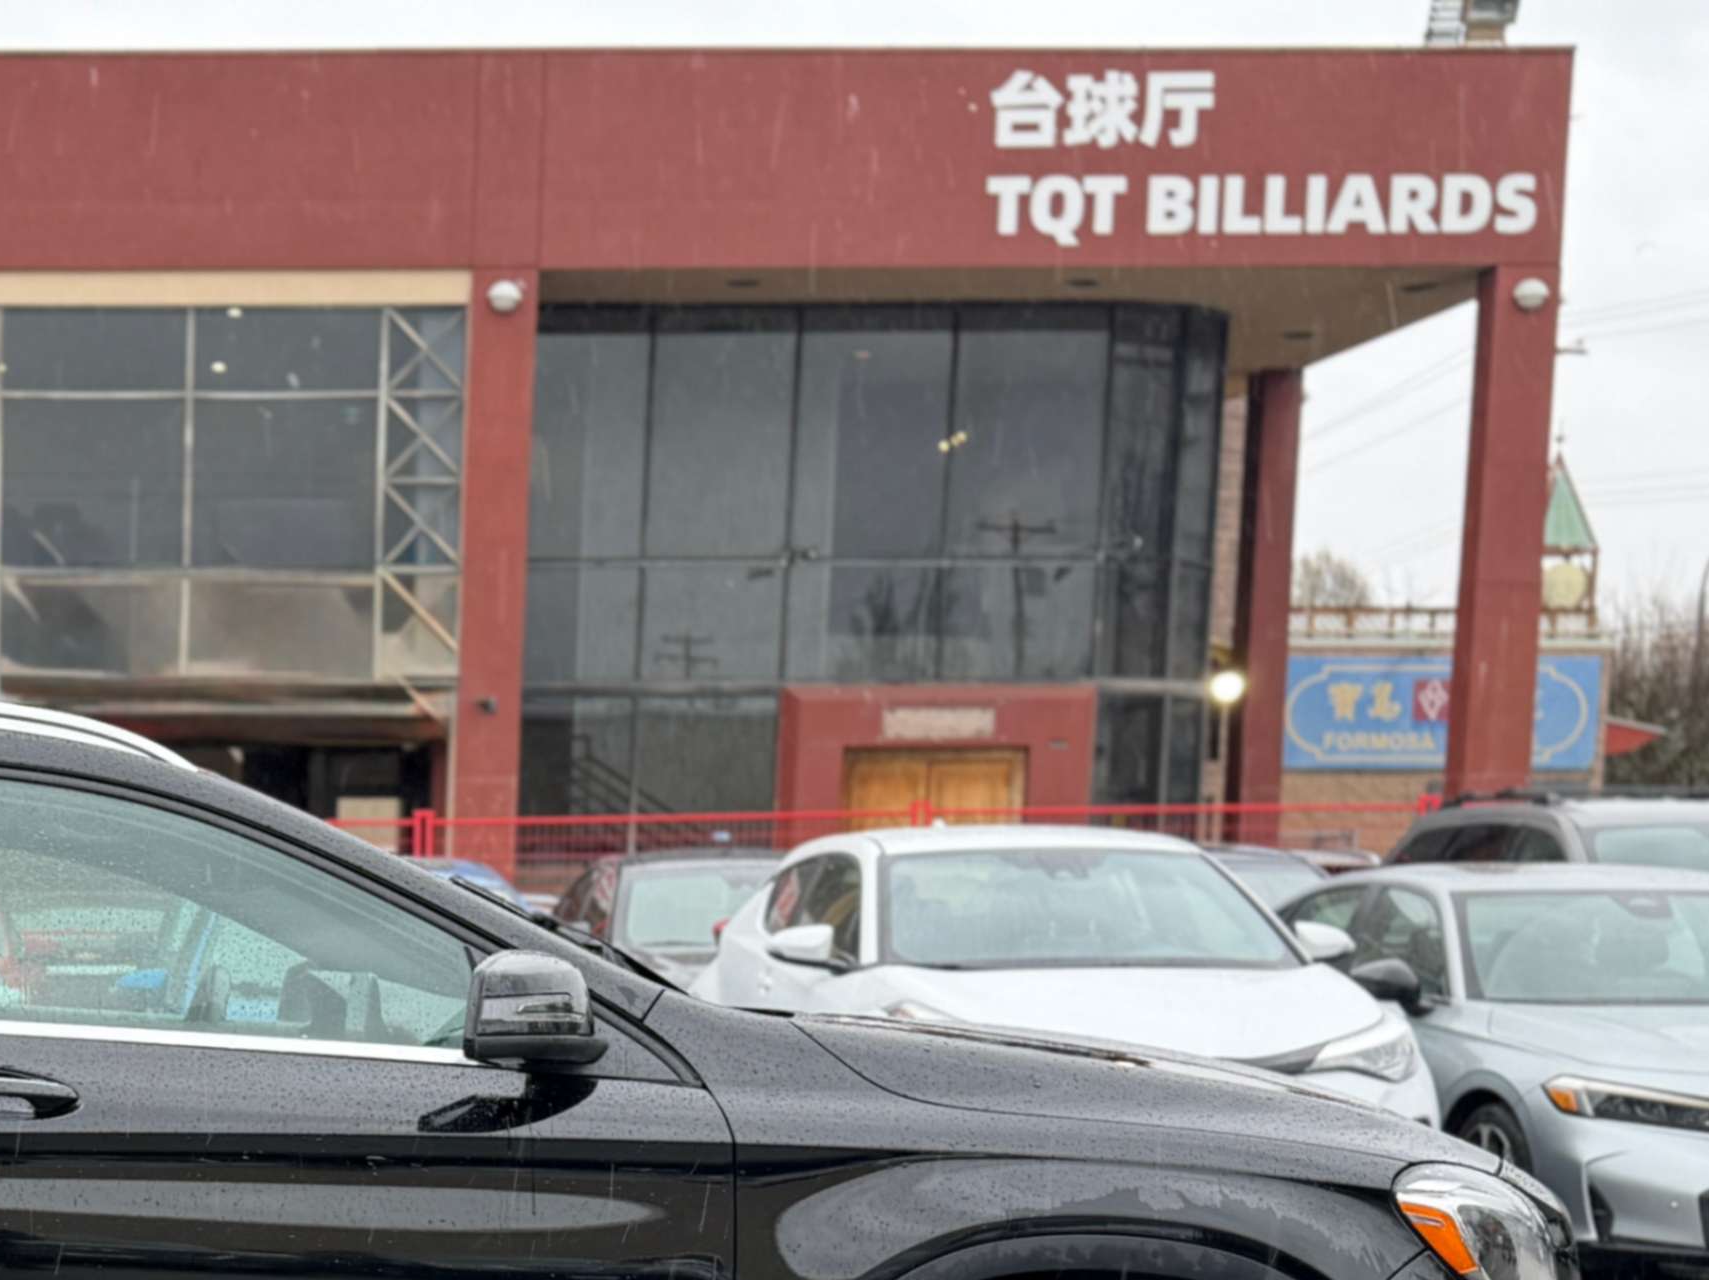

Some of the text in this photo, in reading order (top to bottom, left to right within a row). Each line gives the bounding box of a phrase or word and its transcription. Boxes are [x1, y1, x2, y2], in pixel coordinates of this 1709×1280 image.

[990, 69, 1216, 149] 台球厅
[986, 173, 1538, 247] TQT BILLIARDS
[1322, 730, 1436, 751] FORMOSA
